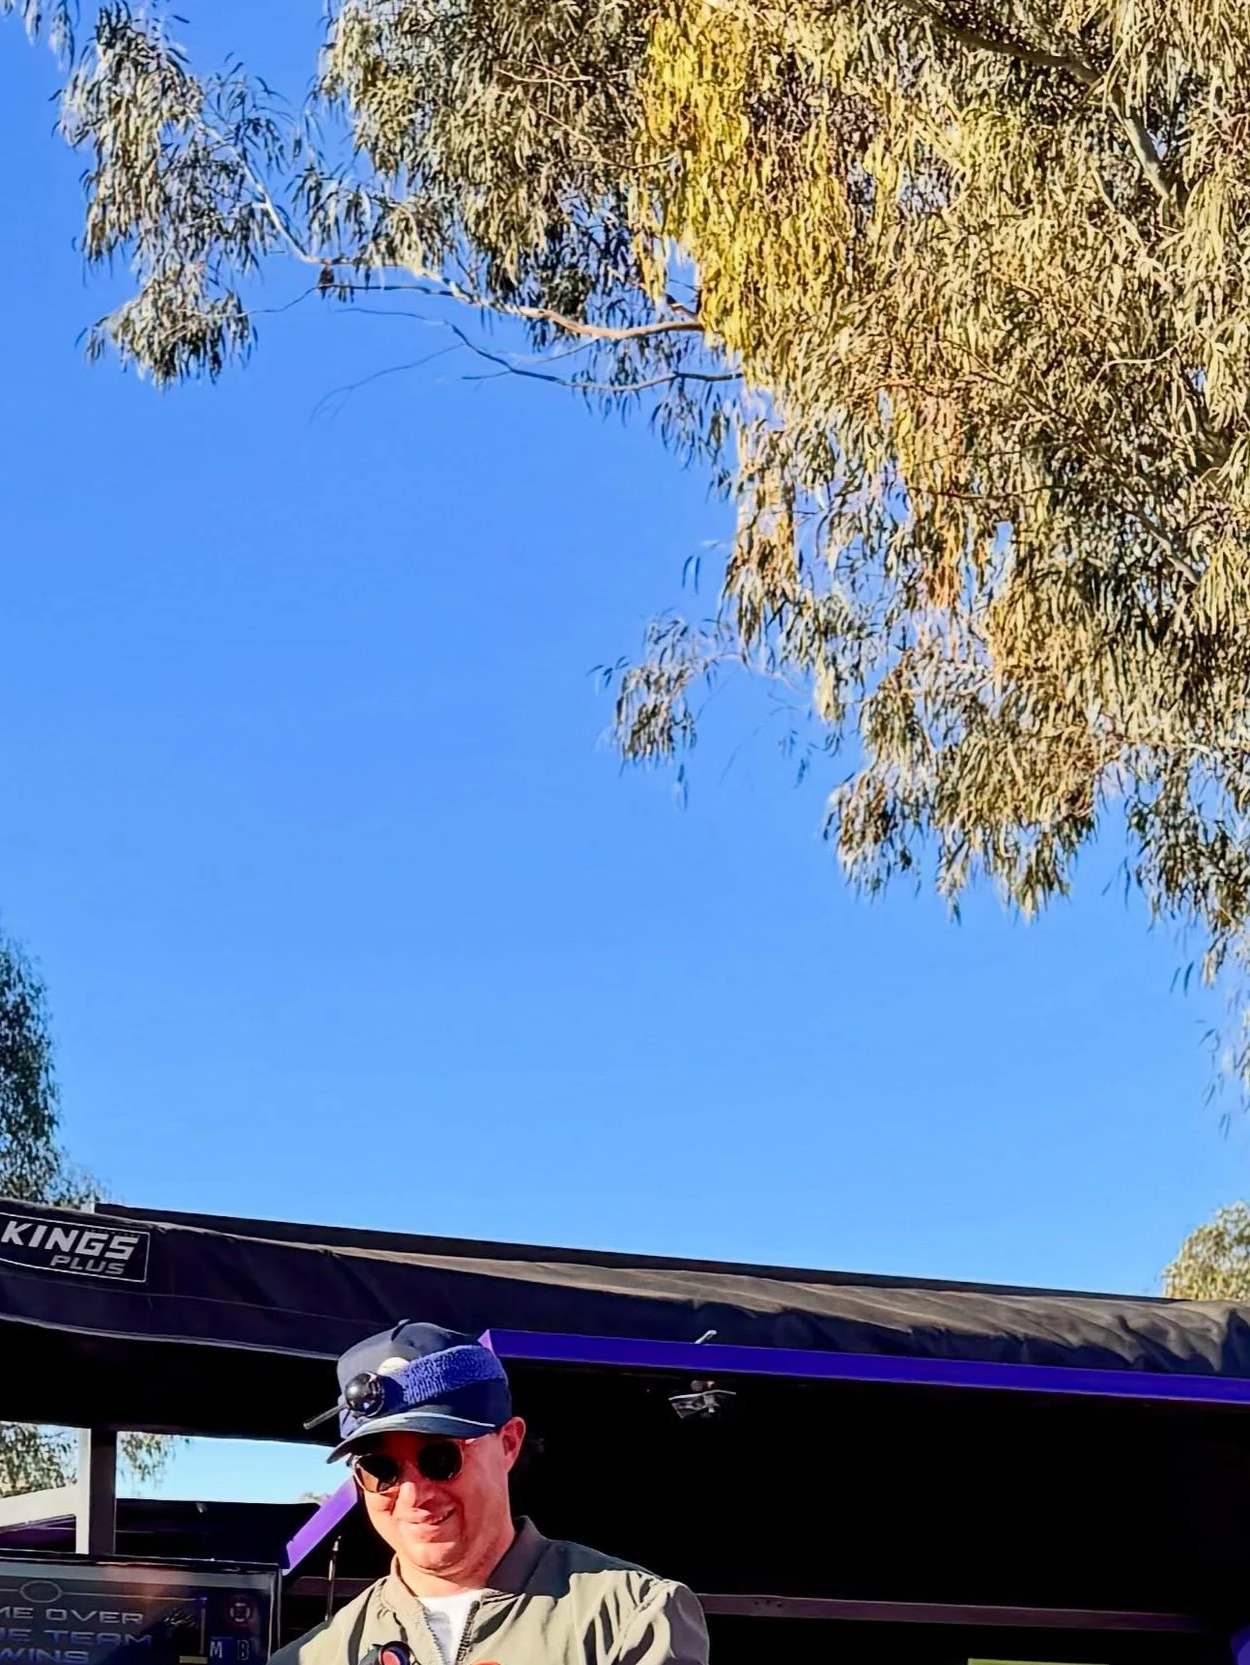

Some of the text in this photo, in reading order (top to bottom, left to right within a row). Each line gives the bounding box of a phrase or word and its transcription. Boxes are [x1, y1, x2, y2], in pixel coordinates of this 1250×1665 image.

[0, 1220, 140, 1260] KINGS
[50, 1254, 126, 1275] PLUS
[45, 1607, 144, 1625] OVER
[43, 1628, 153, 1647] TEAM
